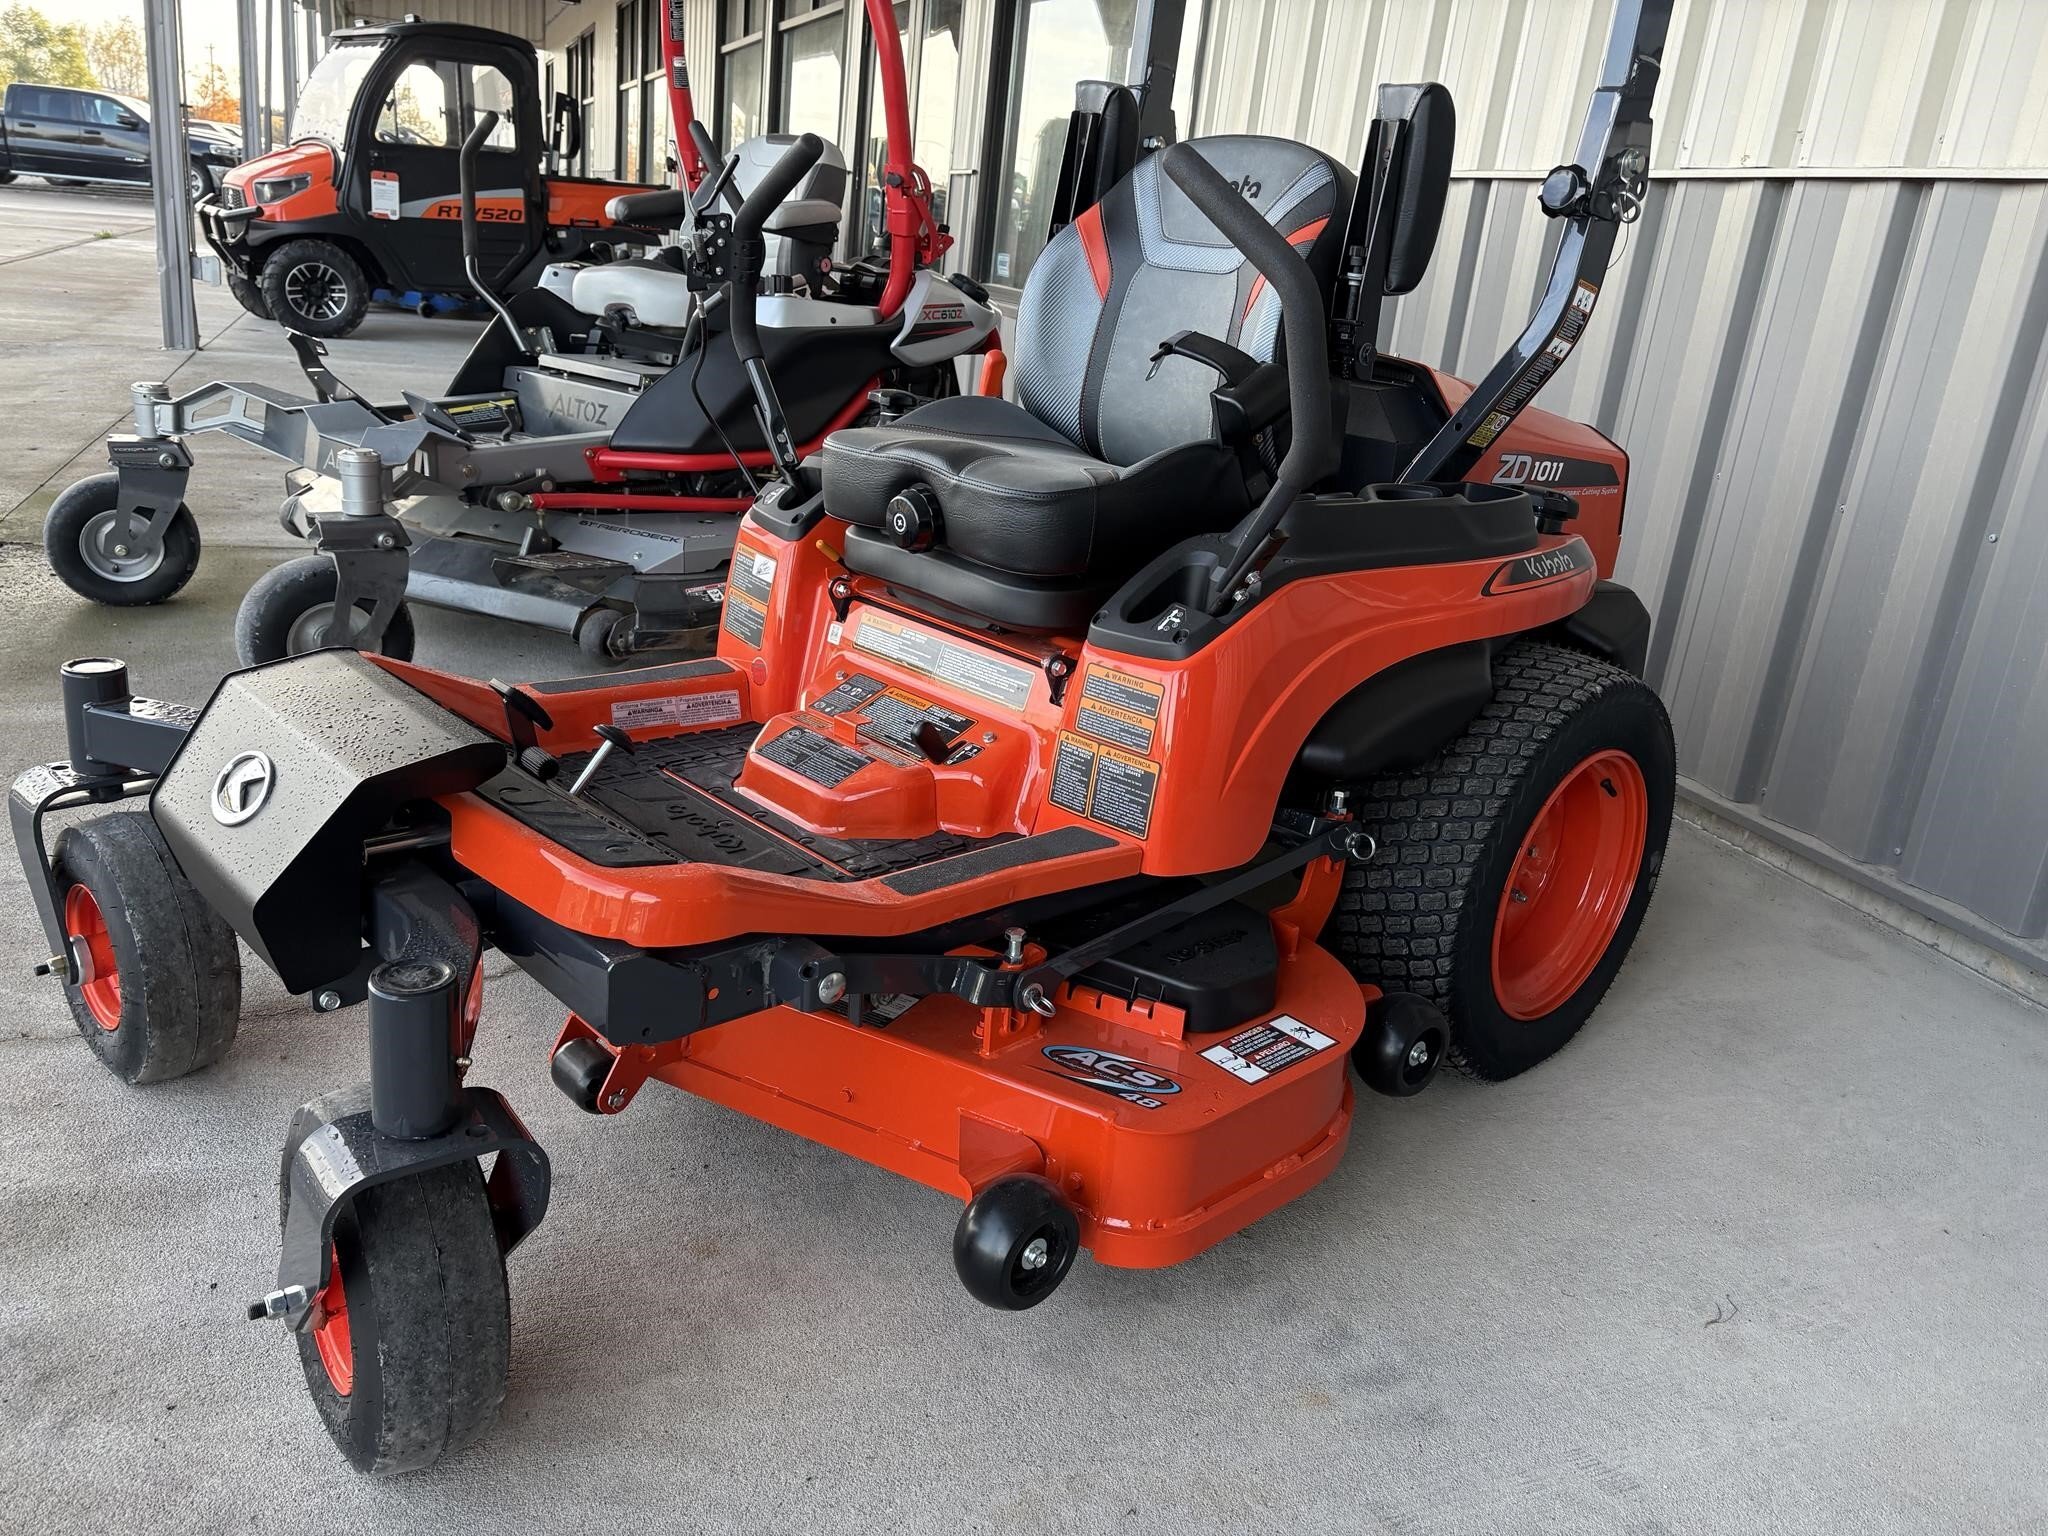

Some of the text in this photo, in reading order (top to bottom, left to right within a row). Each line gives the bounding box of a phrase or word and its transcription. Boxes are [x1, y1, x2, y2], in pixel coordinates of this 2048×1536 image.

[1230, 174, 1262, 199] ota
[923, 309, 963, 321] XC610Z
[549, 393, 609, 426] ALTOZ
[1491, 454, 1564, 484] ZD 1011
[597, 523, 681, 543] AERODECK
[1524, 551, 1575, 578] Kubota
[1110, 672, 1144, 689] WARNING
[691, 698, 726, 708] ADVERTENCIA
[1098, 704, 1143, 725] ADVERTENCIA
[1112, 751, 1151, 769] ADVERTENCIA
[1235, 1026, 1266, 1043] DANGER
[1259, 1040, 1291, 1058] PELIGRO
[1059, 1051, 1166, 1086] ACS
[1119, 1093, 1163, 1108] 48
